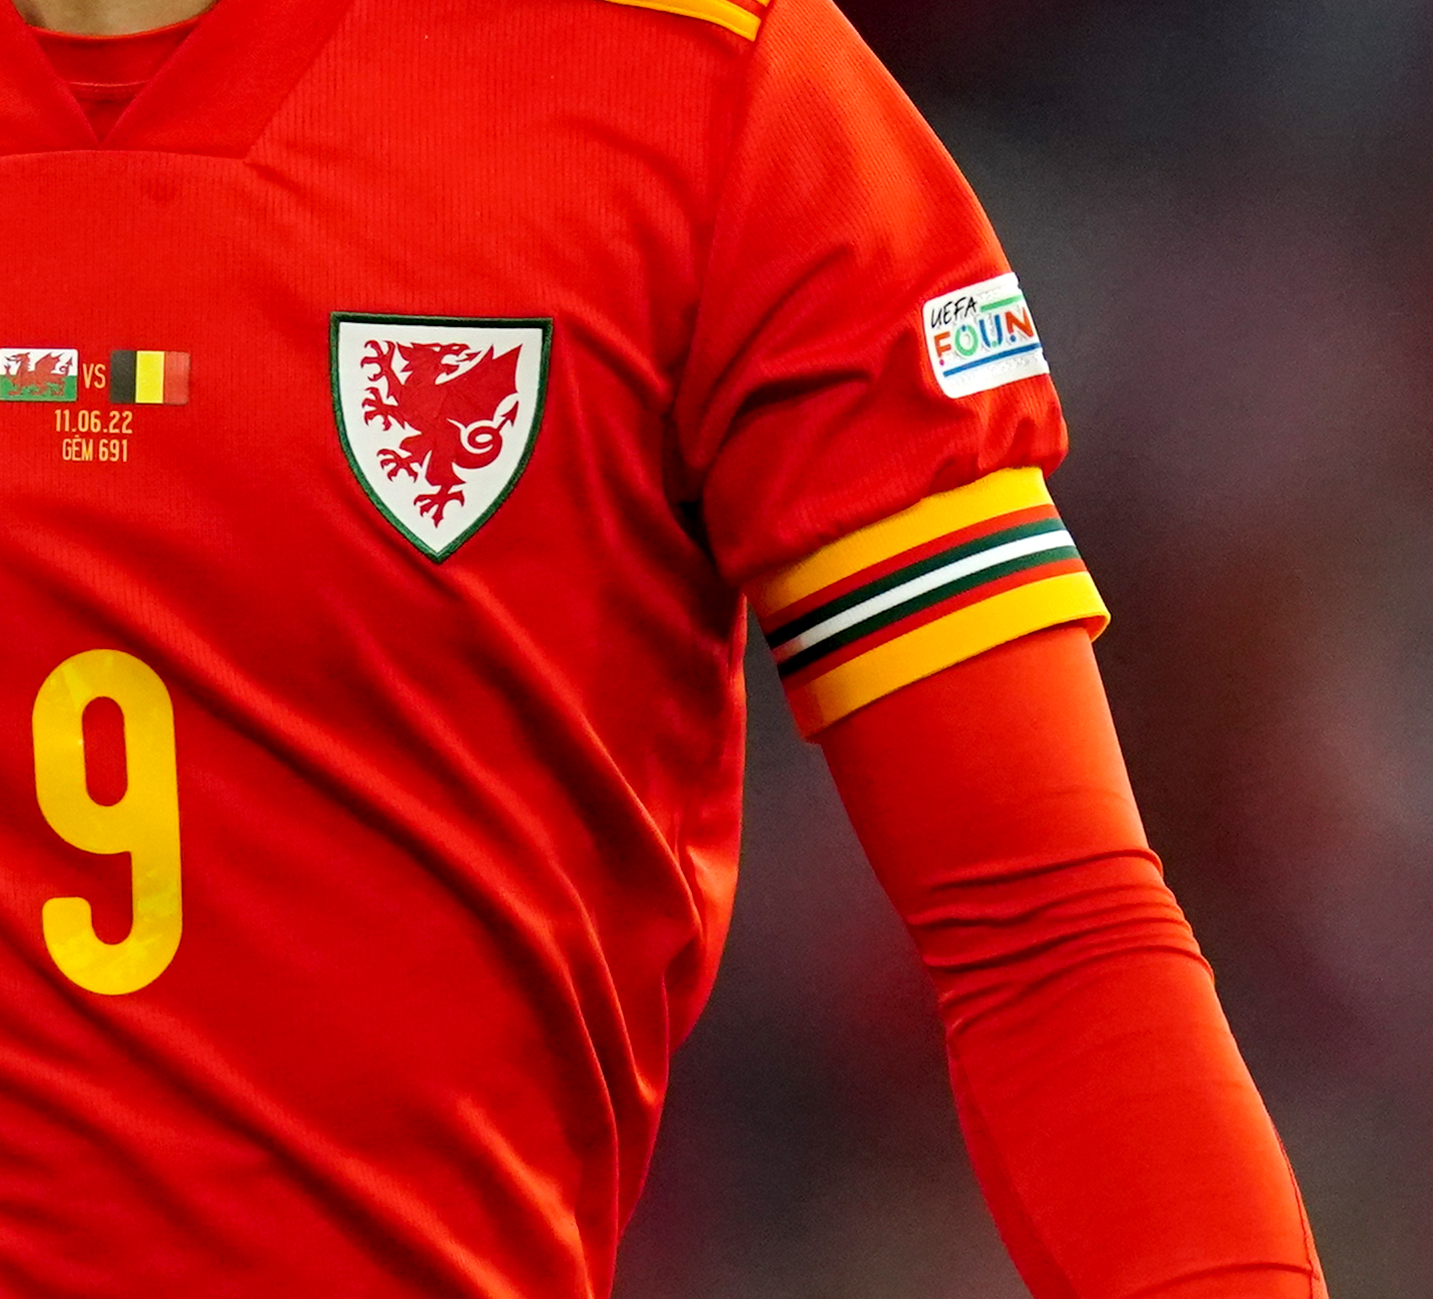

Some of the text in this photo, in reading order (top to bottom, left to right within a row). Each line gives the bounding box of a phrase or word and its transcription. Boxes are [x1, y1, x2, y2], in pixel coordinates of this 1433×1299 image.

[931, 296, 977, 328] UEFA
[82, 363, 106, 389] VS
[54, 409, 133, 434] 11.06.22
[99, 438, 128, 462] 691
[31, 648, 183, 996] 9
